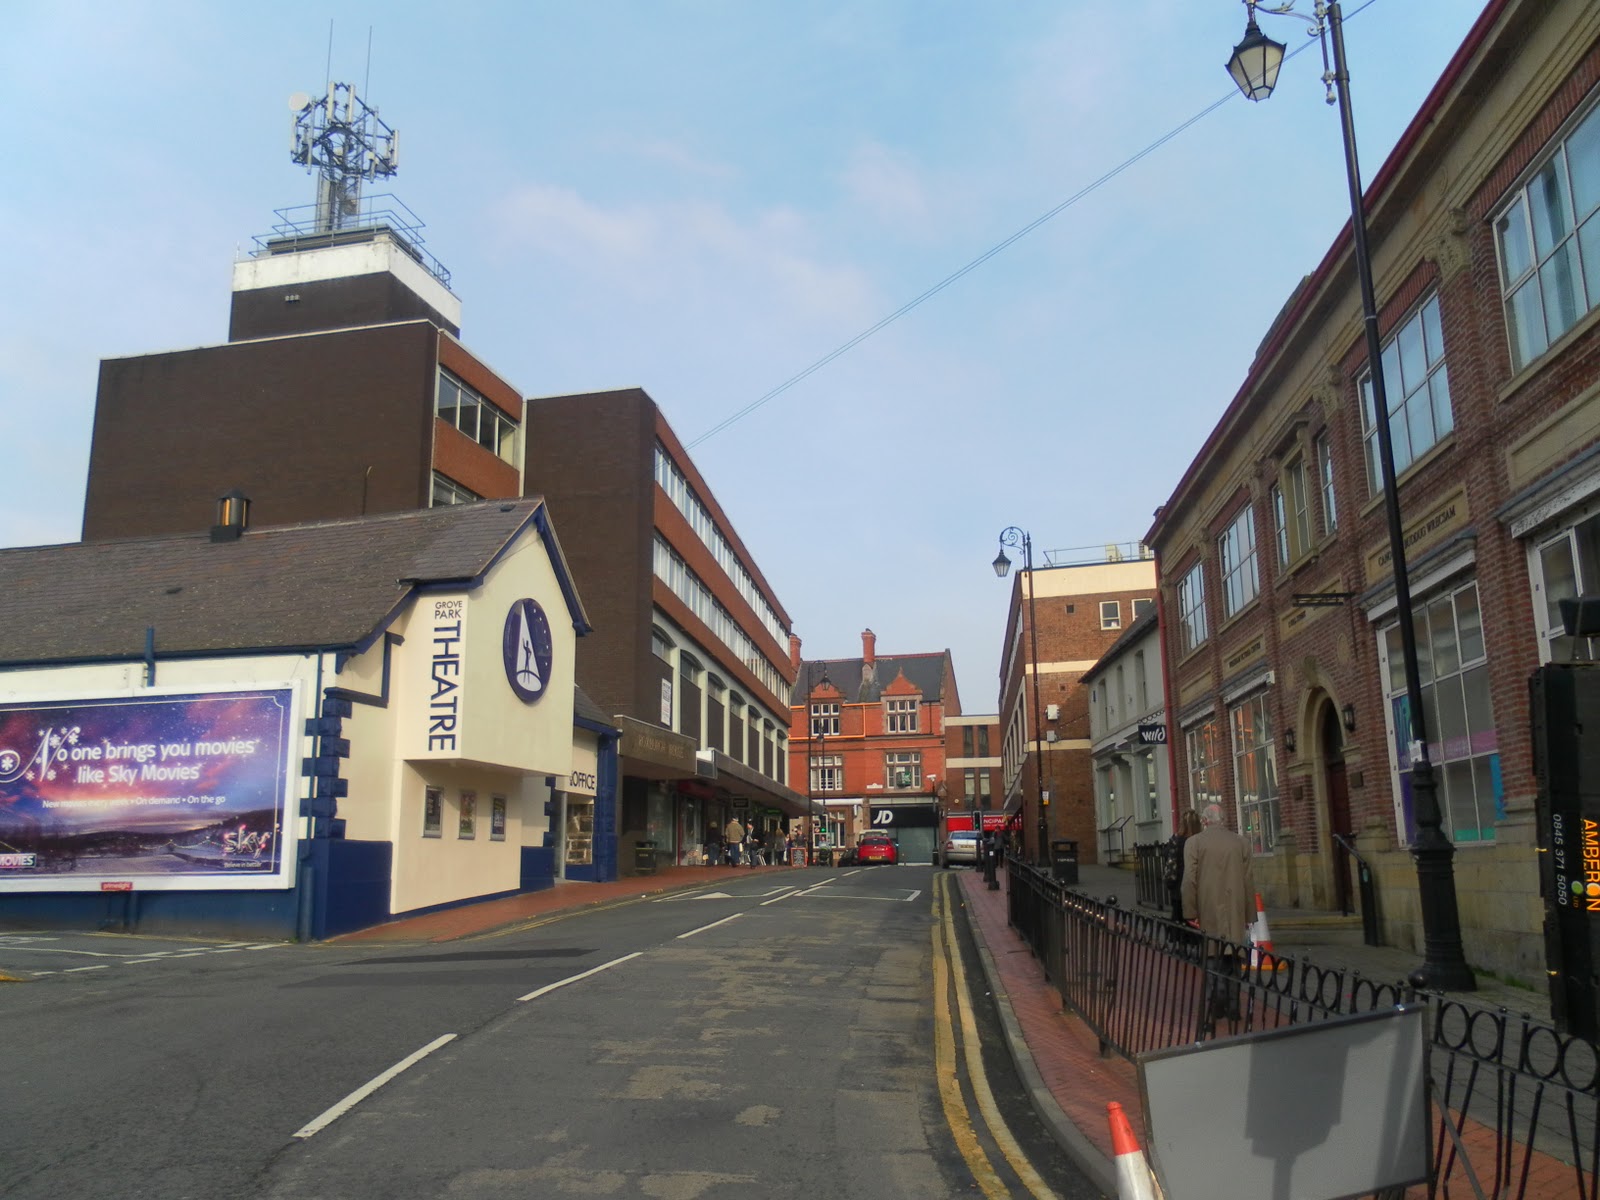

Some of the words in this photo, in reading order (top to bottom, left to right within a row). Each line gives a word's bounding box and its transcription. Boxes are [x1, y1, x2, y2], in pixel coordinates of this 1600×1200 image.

[1426, 504, 1456, 533] WRECSAM
[434, 609, 462, 619] PARK
[435, 600, 463, 609] GROVE
[428, 620, 461, 751] THEATRE
[1142, 726, 1166, 742] wild
[71, 746, 102, 760] one
[105, 741, 156, 762] brings
[160, 743, 191, 761] you
[195, 739, 255, 756] movies
[77, 765, 105, 784] like
[108, 764, 138, 786] Sky
[141, 763, 200, 781] Movies
[572, 770, 595, 790] OFFICE
[42, 800, 59, 808] New
[135, 797, 147, 805] On
[148, 796, 181, 804] demand
[187, 795, 199, 804] On
[200, 795, 214, 803] the
[215, 796, 226, 805] go
[873, 810, 893, 824] JD
[1553, 813, 1563, 845] 0845
[224, 824, 271, 859] sky
[1555, 849, 1565, 870] 371
[1557, 874, 1567, 905] 5050
